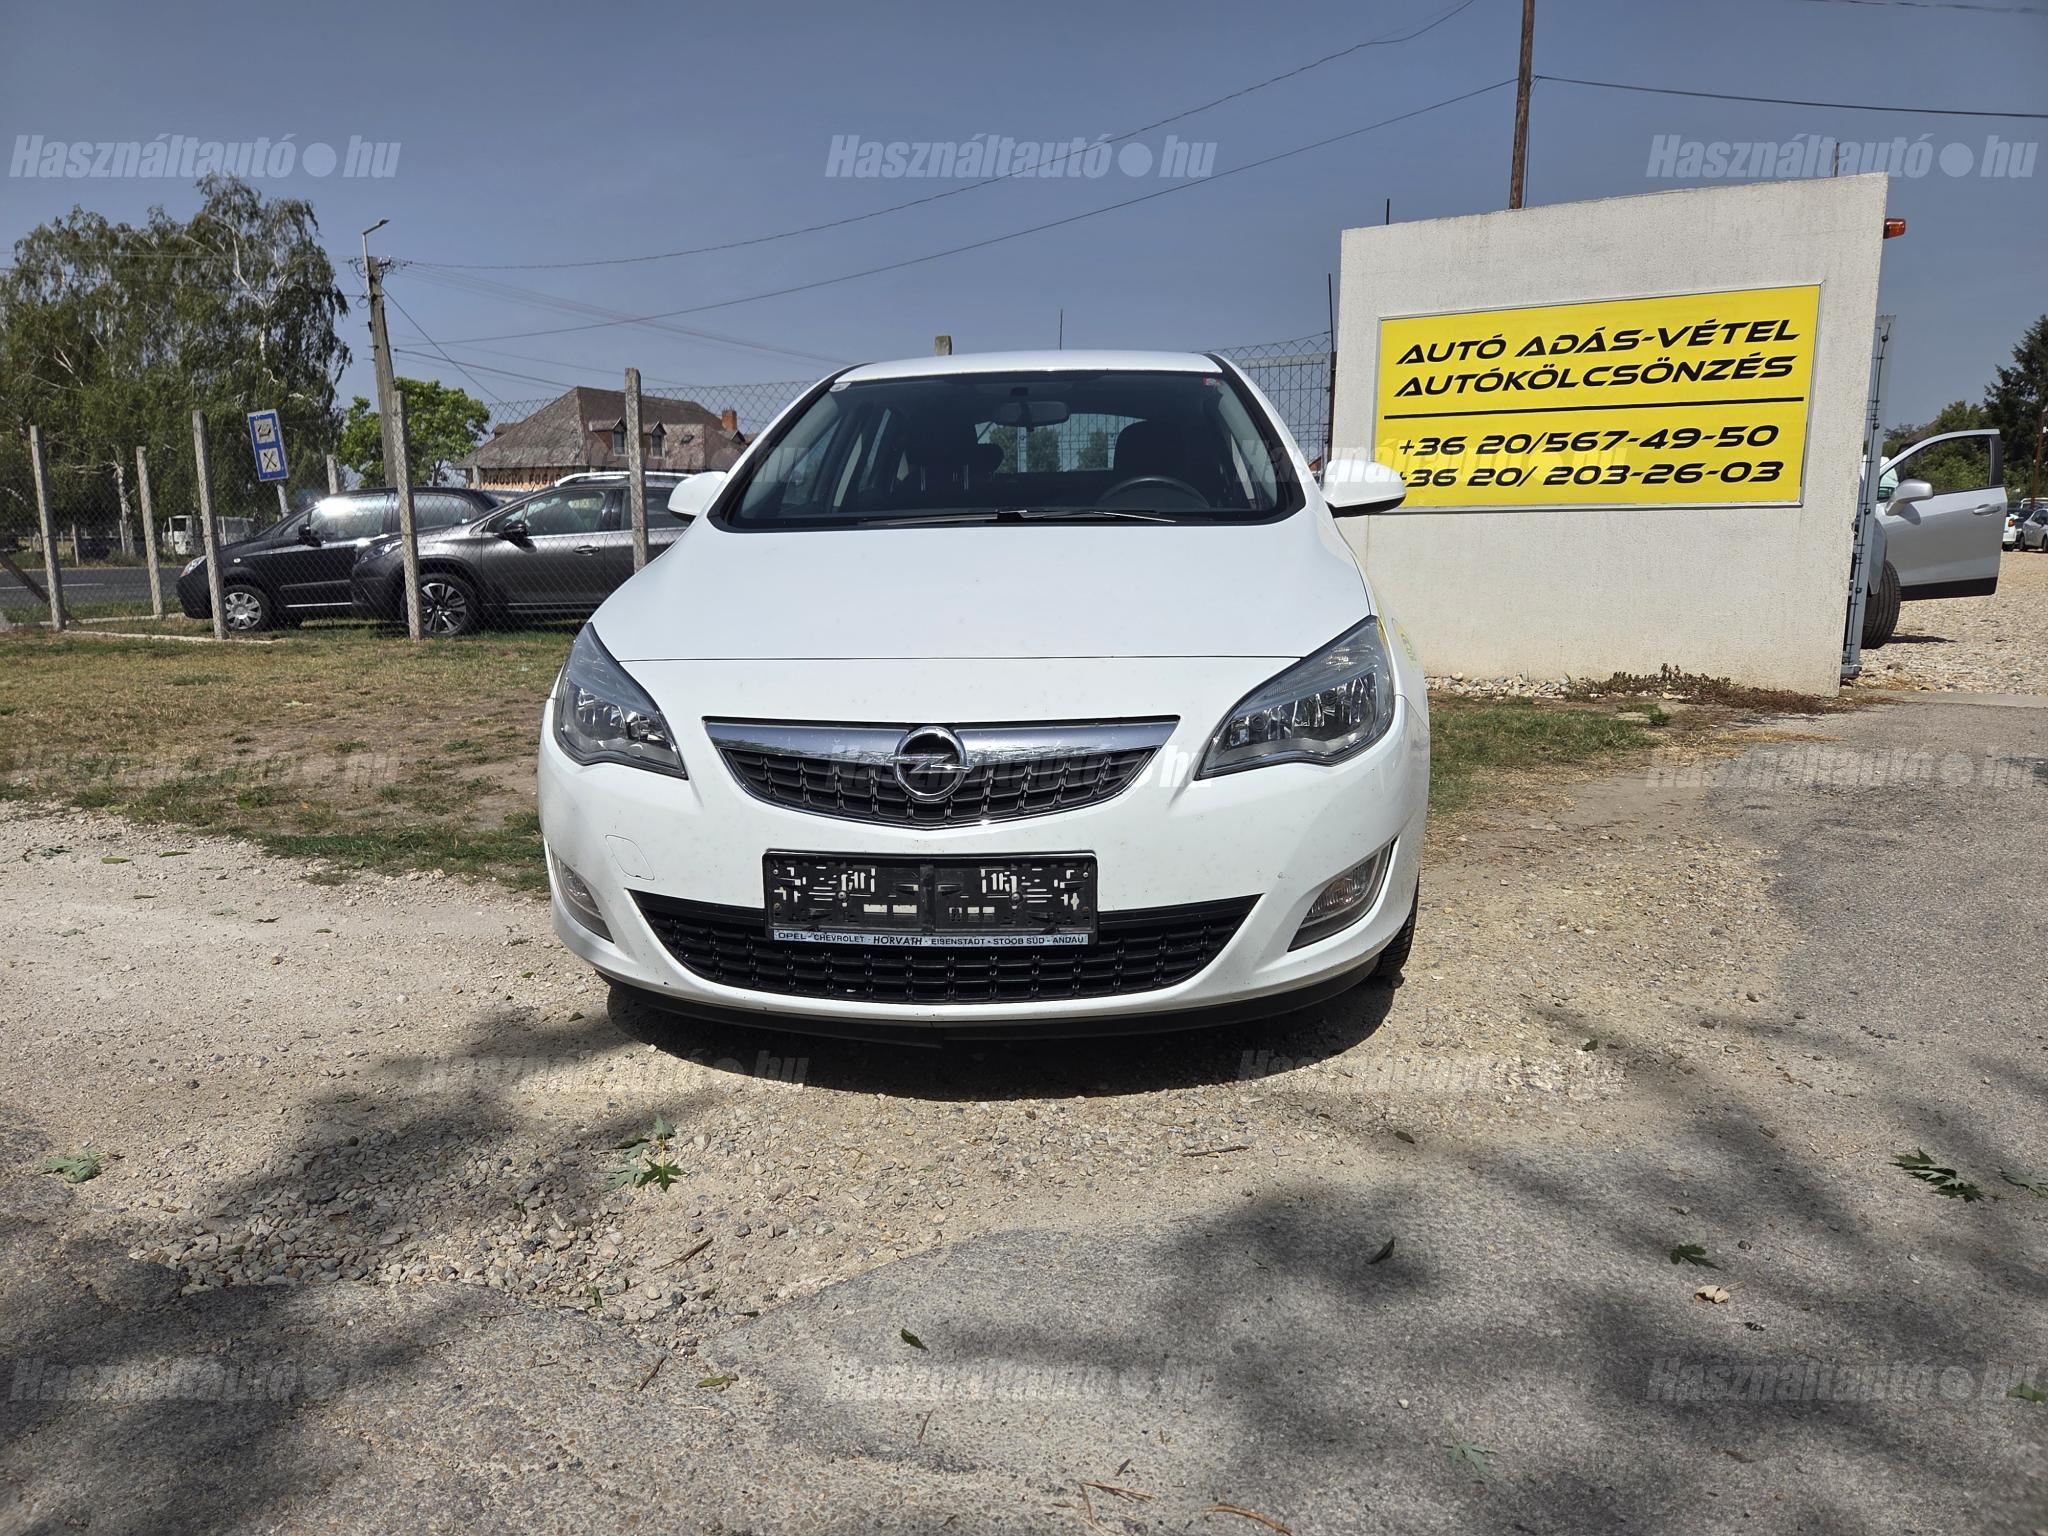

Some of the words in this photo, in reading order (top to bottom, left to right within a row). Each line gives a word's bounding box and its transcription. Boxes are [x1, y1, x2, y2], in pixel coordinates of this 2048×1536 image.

[1396, 334, 1507, 364] AUTÓ
[1515, 319, 1800, 357] ADÁS-VÉTEL
[1394, 352, 1797, 397] AUTÓKÖLCSÖNZÉS
[1399, 436, 1467, 456] +36
[1476, 425, 1779, 455] 20/567-49-50
[1467, 467, 1537, 487] 20/
[1544, 460, 1784, 486] 203-26-03
